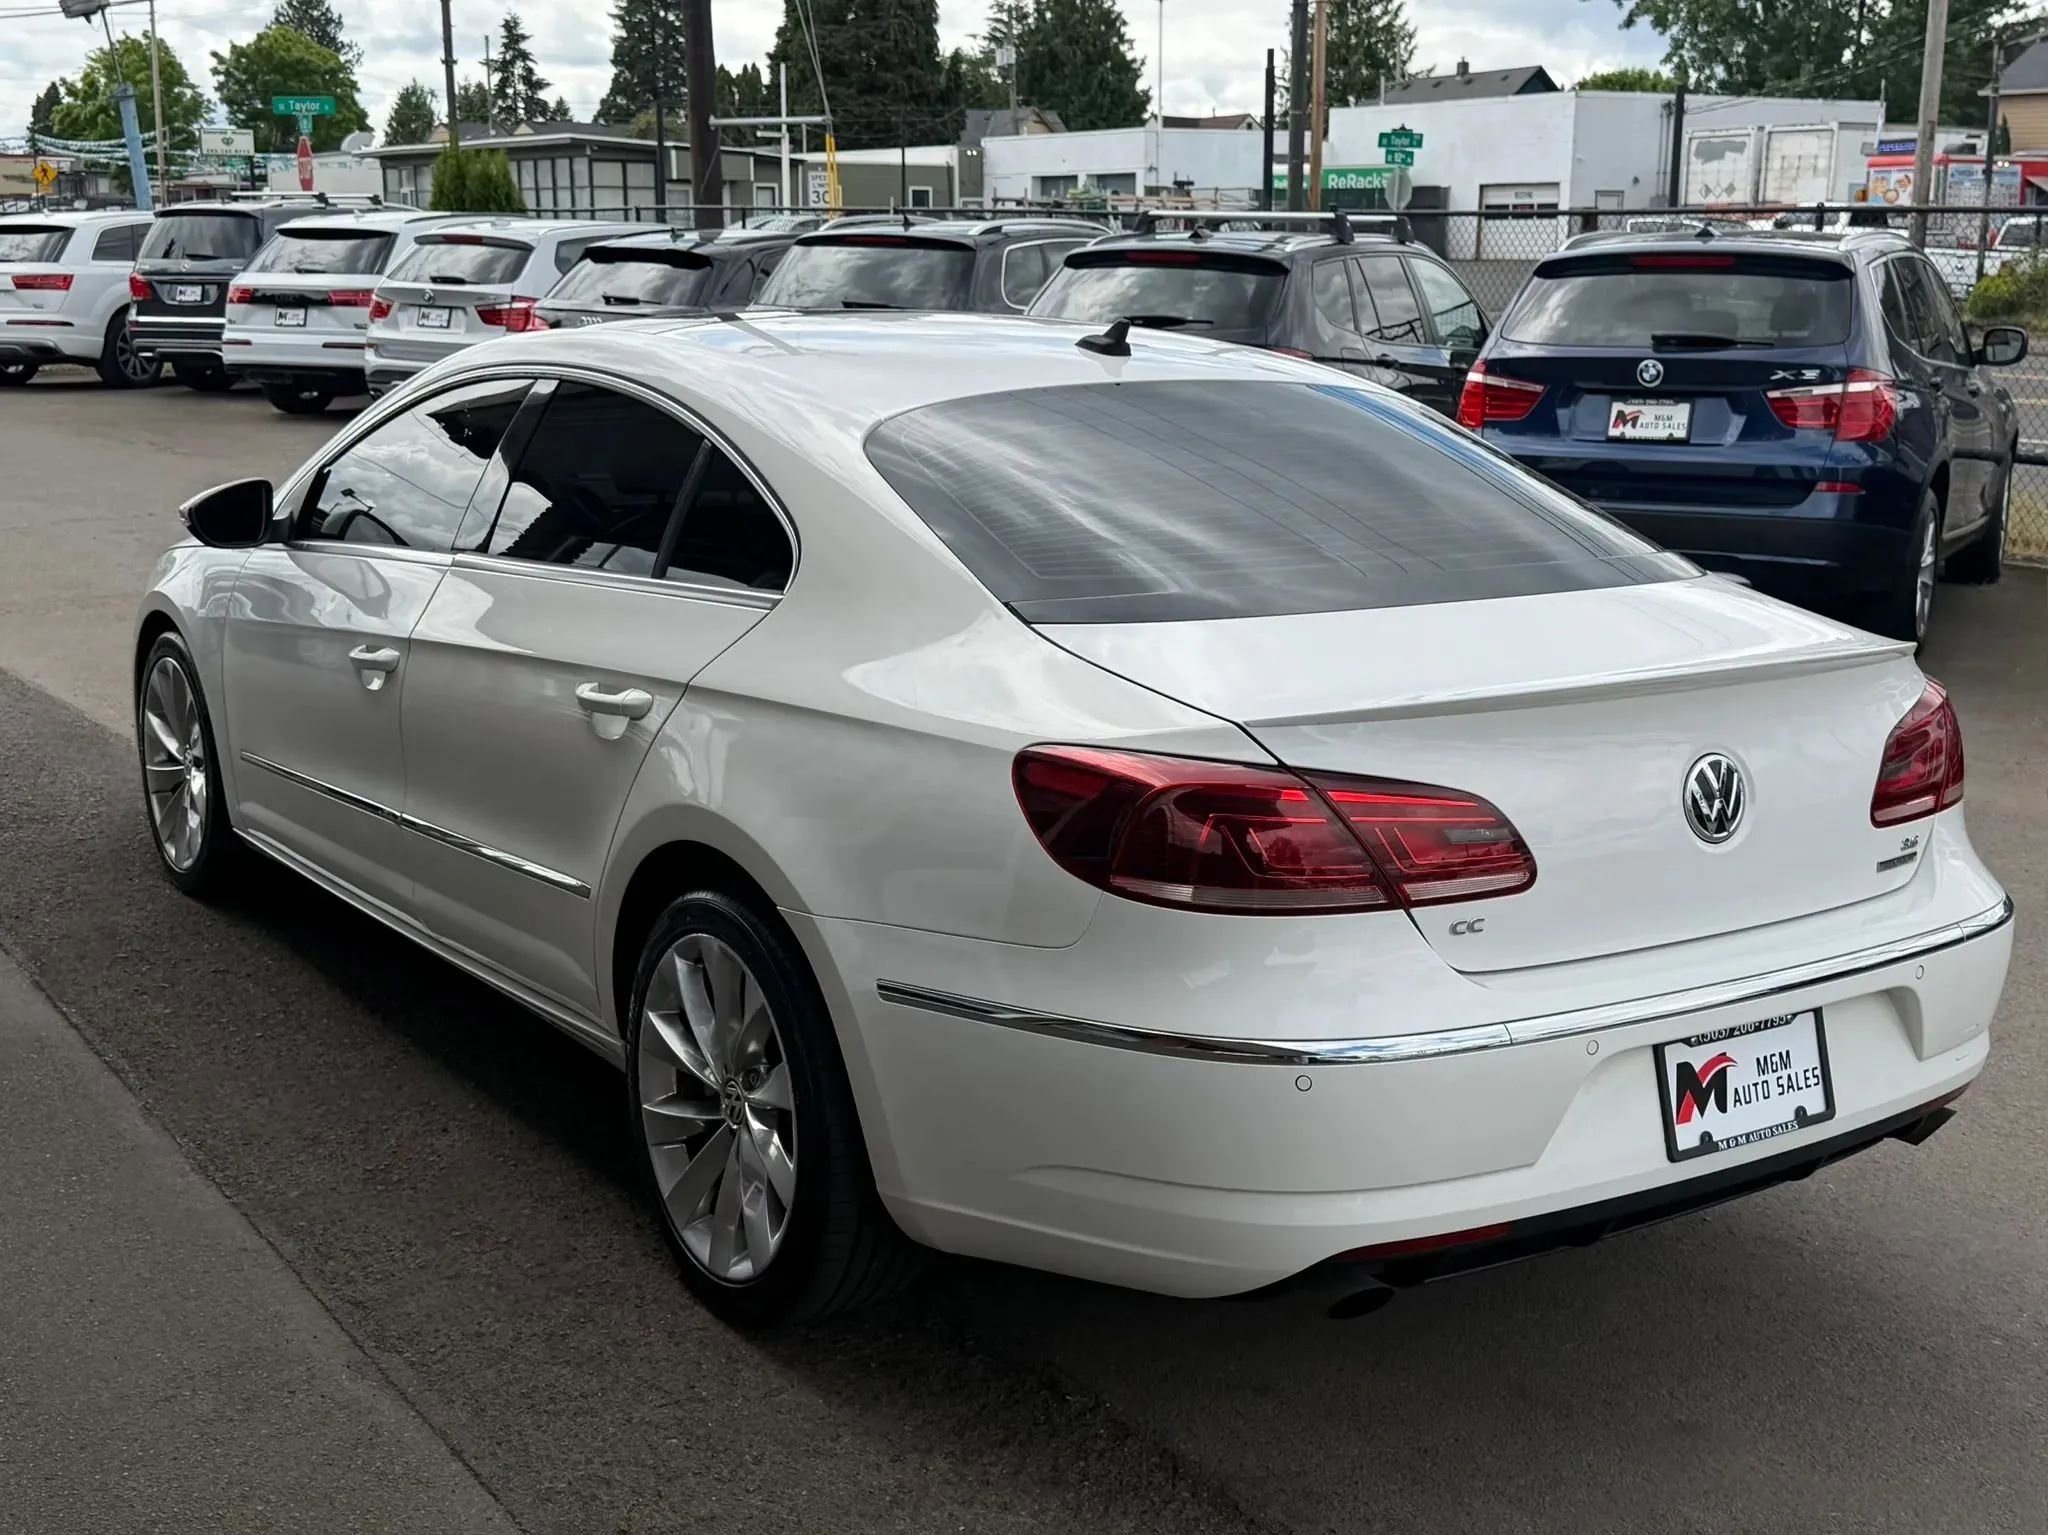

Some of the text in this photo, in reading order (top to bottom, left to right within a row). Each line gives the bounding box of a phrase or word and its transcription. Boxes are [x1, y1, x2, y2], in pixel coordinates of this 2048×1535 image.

[288, 100, 321, 113] Taylor
[1639, 421, 1687, 431] AUTO SALES
[1449, 918, 1486, 936] CC
[1755, 1049, 1792, 1077] M&M
[1733, 1067, 1820, 1108] AUTO SALES
[1748, 1128, 1773, 1142] AUTO
[1773, 1121, 1799, 1136] SALES
